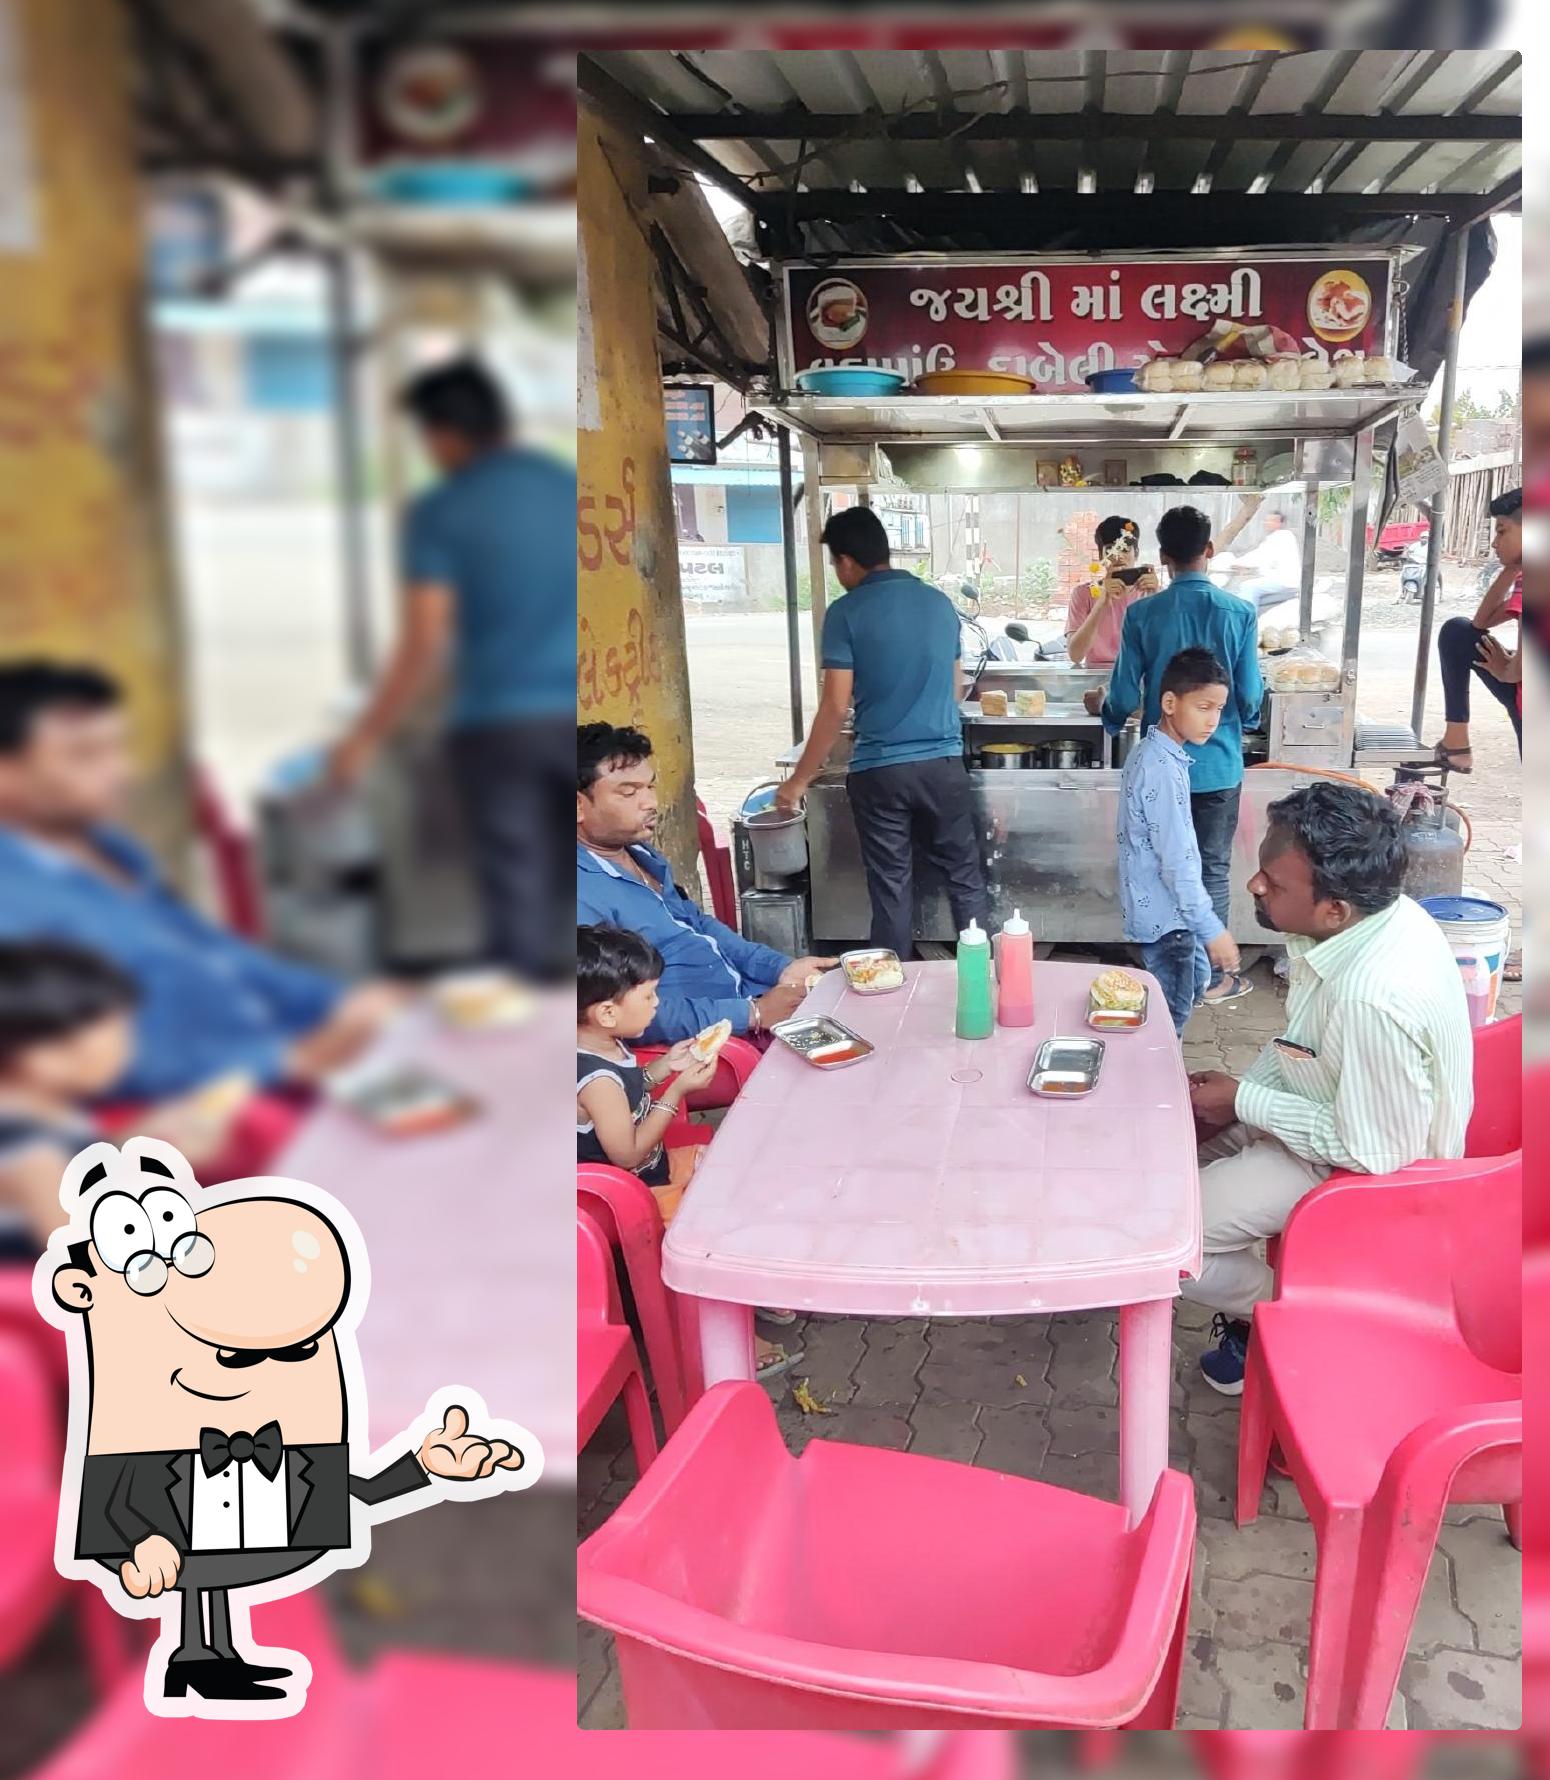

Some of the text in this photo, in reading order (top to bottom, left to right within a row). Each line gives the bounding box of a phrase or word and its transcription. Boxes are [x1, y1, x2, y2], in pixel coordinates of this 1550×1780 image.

[909, 267, 1263, 322] જયશ્રી માં લક્ષ્મી
